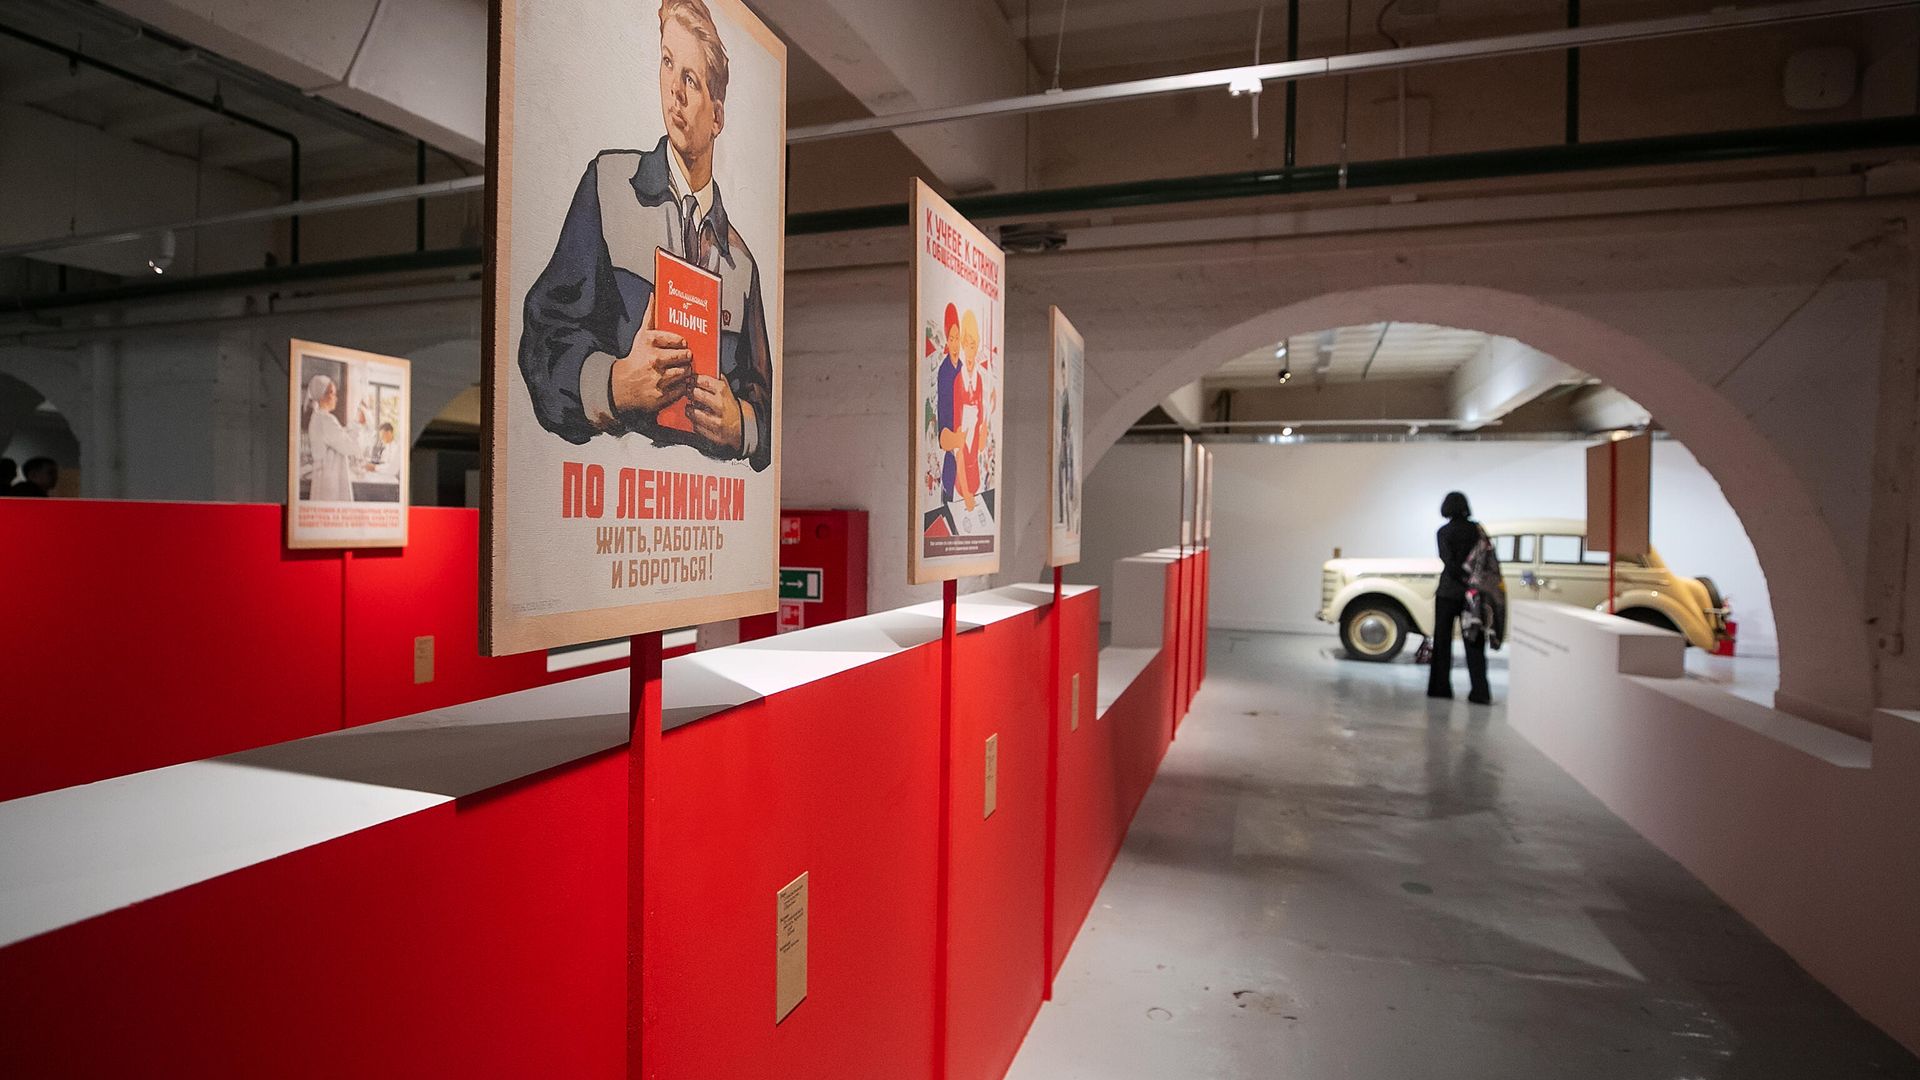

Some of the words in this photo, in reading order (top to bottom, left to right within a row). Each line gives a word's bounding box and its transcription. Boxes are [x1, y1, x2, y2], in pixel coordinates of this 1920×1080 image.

[926, 235, 931, 255] К
[926, 208, 932, 236] К
[935, 214, 962, 258] УЧЕБЕ
[965, 239, 971, 265] К
[972, 246, 999, 285] СТАНКУ
[669, 307, 708, 335] ИЛЬИЧЕ
[562, 461, 604, 518] ПО
[616, 467, 745, 520] ЛЕНИНСКИ
[596, 525, 651, 555] ЖИТЬ,
[653, 526, 724, 552] РАБОТАТЬ
[611, 560, 623, 589] И
